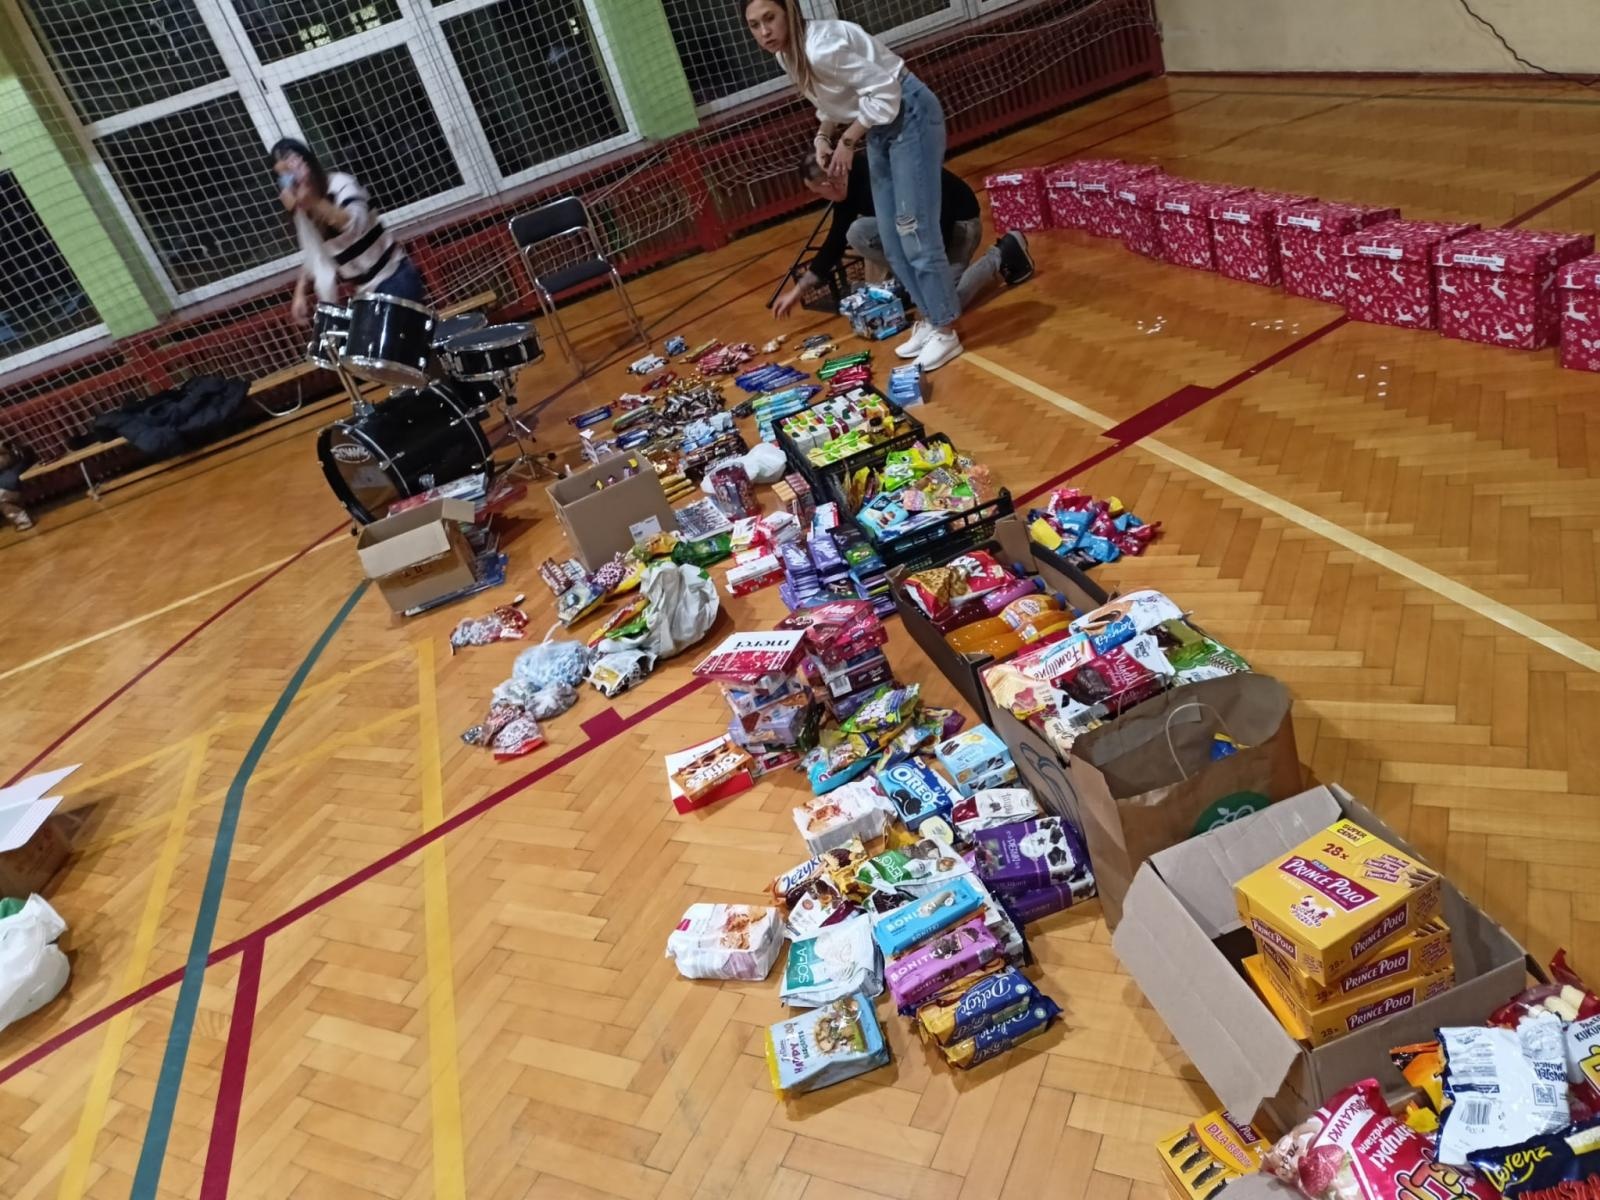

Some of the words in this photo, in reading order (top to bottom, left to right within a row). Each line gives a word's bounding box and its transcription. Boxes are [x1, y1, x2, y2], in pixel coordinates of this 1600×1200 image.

[734, 639, 790, 649] merci
[1034, 645, 1082, 681] Familijne
[892, 767, 933, 803] OREO
[1342, 823, 1368, 839] SUPER
[1284, 858, 1333, 886] PRINCE
[1326, 878, 1365, 903] POLO
[1253, 920, 1277, 941] PRINCE
[1275, 933, 1294, 953] POLO
[1354, 927, 1381, 957] PRINCE
[1383, 911, 1405, 933] POLO
[796, 946, 809, 983] SOLA
[890, 948, 943, 981] BONITKI
[1345, 968, 1379, 990] PRINCE
[1379, 956, 1406, 974] POLO
[960, 976, 1011, 1016] Delicje
[1349, 1006, 1382, 1028] PRINCE
[1384, 995, 1411, 1013] POLO
[1207, 1122, 1227, 1145] DLA
[1481, 1145, 1553, 1192] Lorenz
